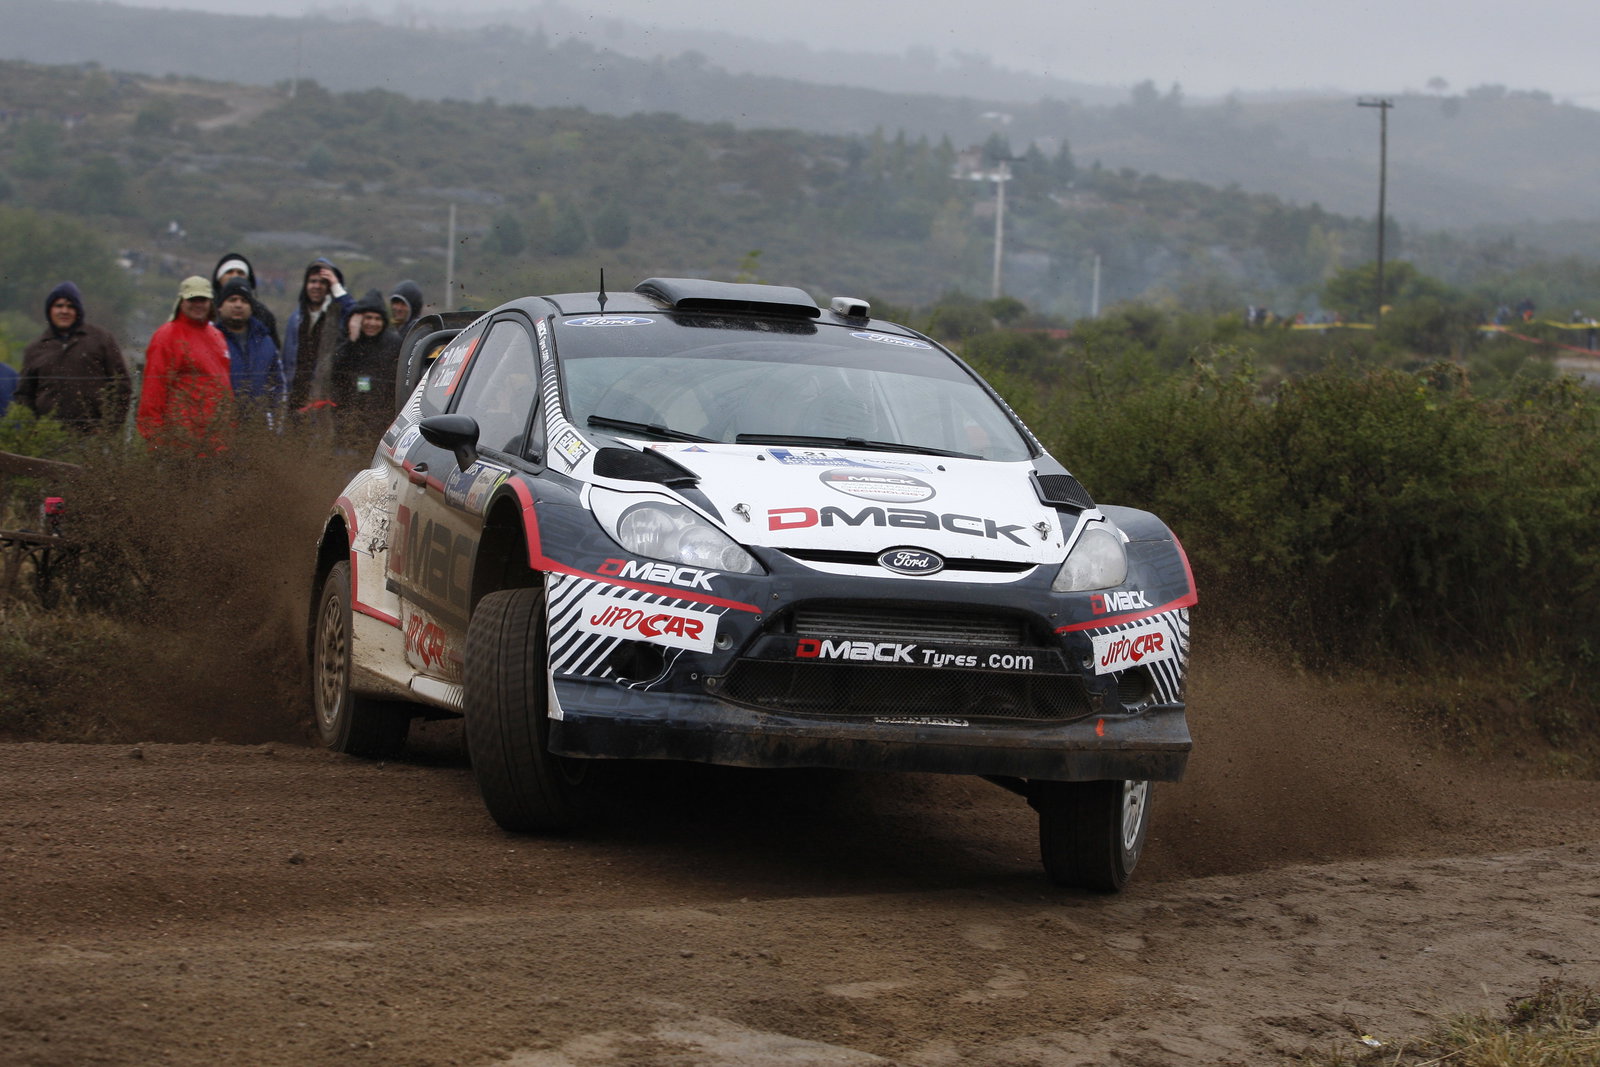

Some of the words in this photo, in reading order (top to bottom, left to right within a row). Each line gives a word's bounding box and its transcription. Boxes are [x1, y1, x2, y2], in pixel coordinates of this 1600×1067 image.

[582, 317, 637, 326] Ford
[868, 333, 918, 347] Ford
[767, 505, 1032, 547] DMACK
[892, 551, 930, 569] Ford
[596, 558, 720, 592] DMACK
[1090, 590, 1154, 615] DMACK
[795, 638, 917, 664] DMACK
